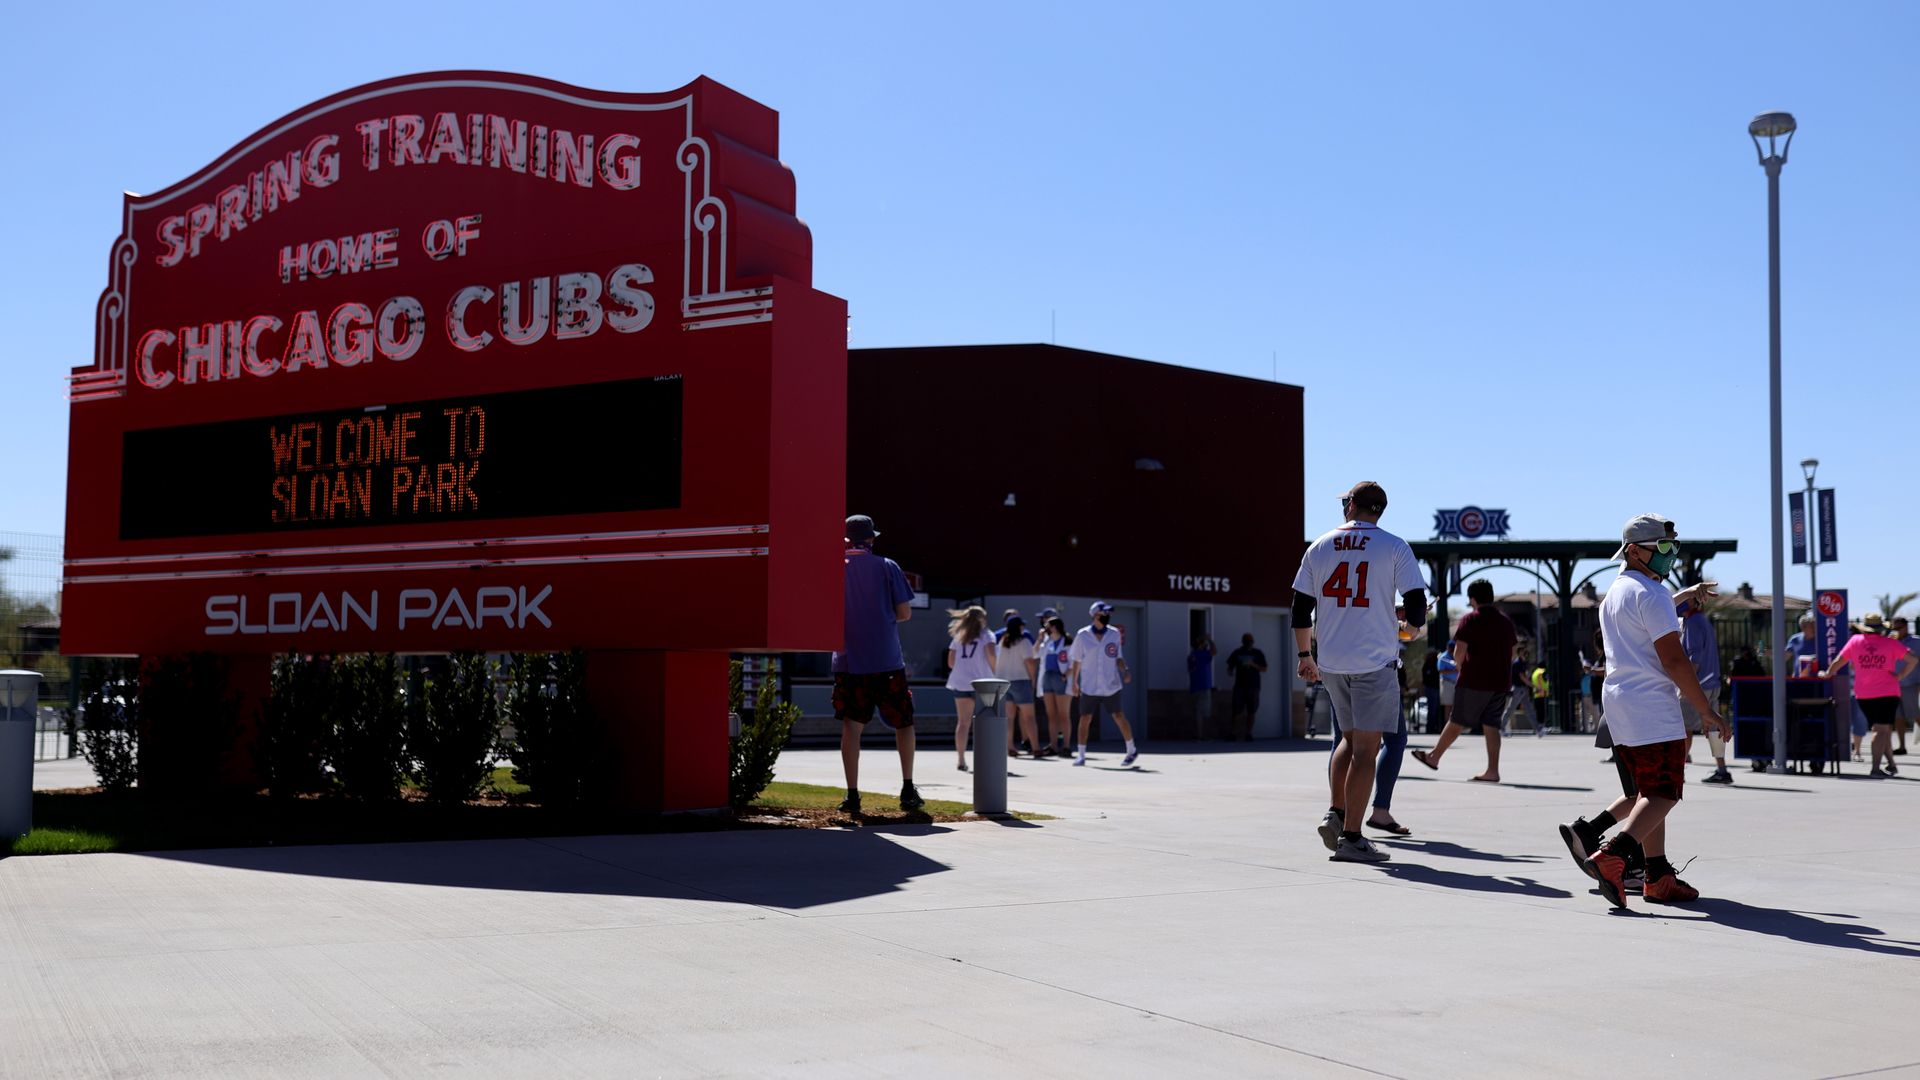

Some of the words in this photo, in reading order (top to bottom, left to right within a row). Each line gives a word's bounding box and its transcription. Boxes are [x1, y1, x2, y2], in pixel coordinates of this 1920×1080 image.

[156, 134, 340, 268] SPRING
[355, 112, 641, 191] TRAINING
[279, 228, 400, 283] HOME
[422, 214, 483, 261] OF
[135, 296, 426, 390] CHICAGO
[446, 263, 656, 352] CUBS
[270, 411, 422, 474] WELCOME
[443, 405, 486, 458] TO
[271, 468, 372, 523] SLOAN
[392, 460, 480, 516] PARK
[1333, 535, 1371, 551] SALE
[205, 589, 379, 636] SLOAN
[399, 584, 553, 631] PARK
[1168, 574, 1231, 592] TICKETS
[1322, 561, 1370, 608] 41
[961, 641, 979, 659] 17
